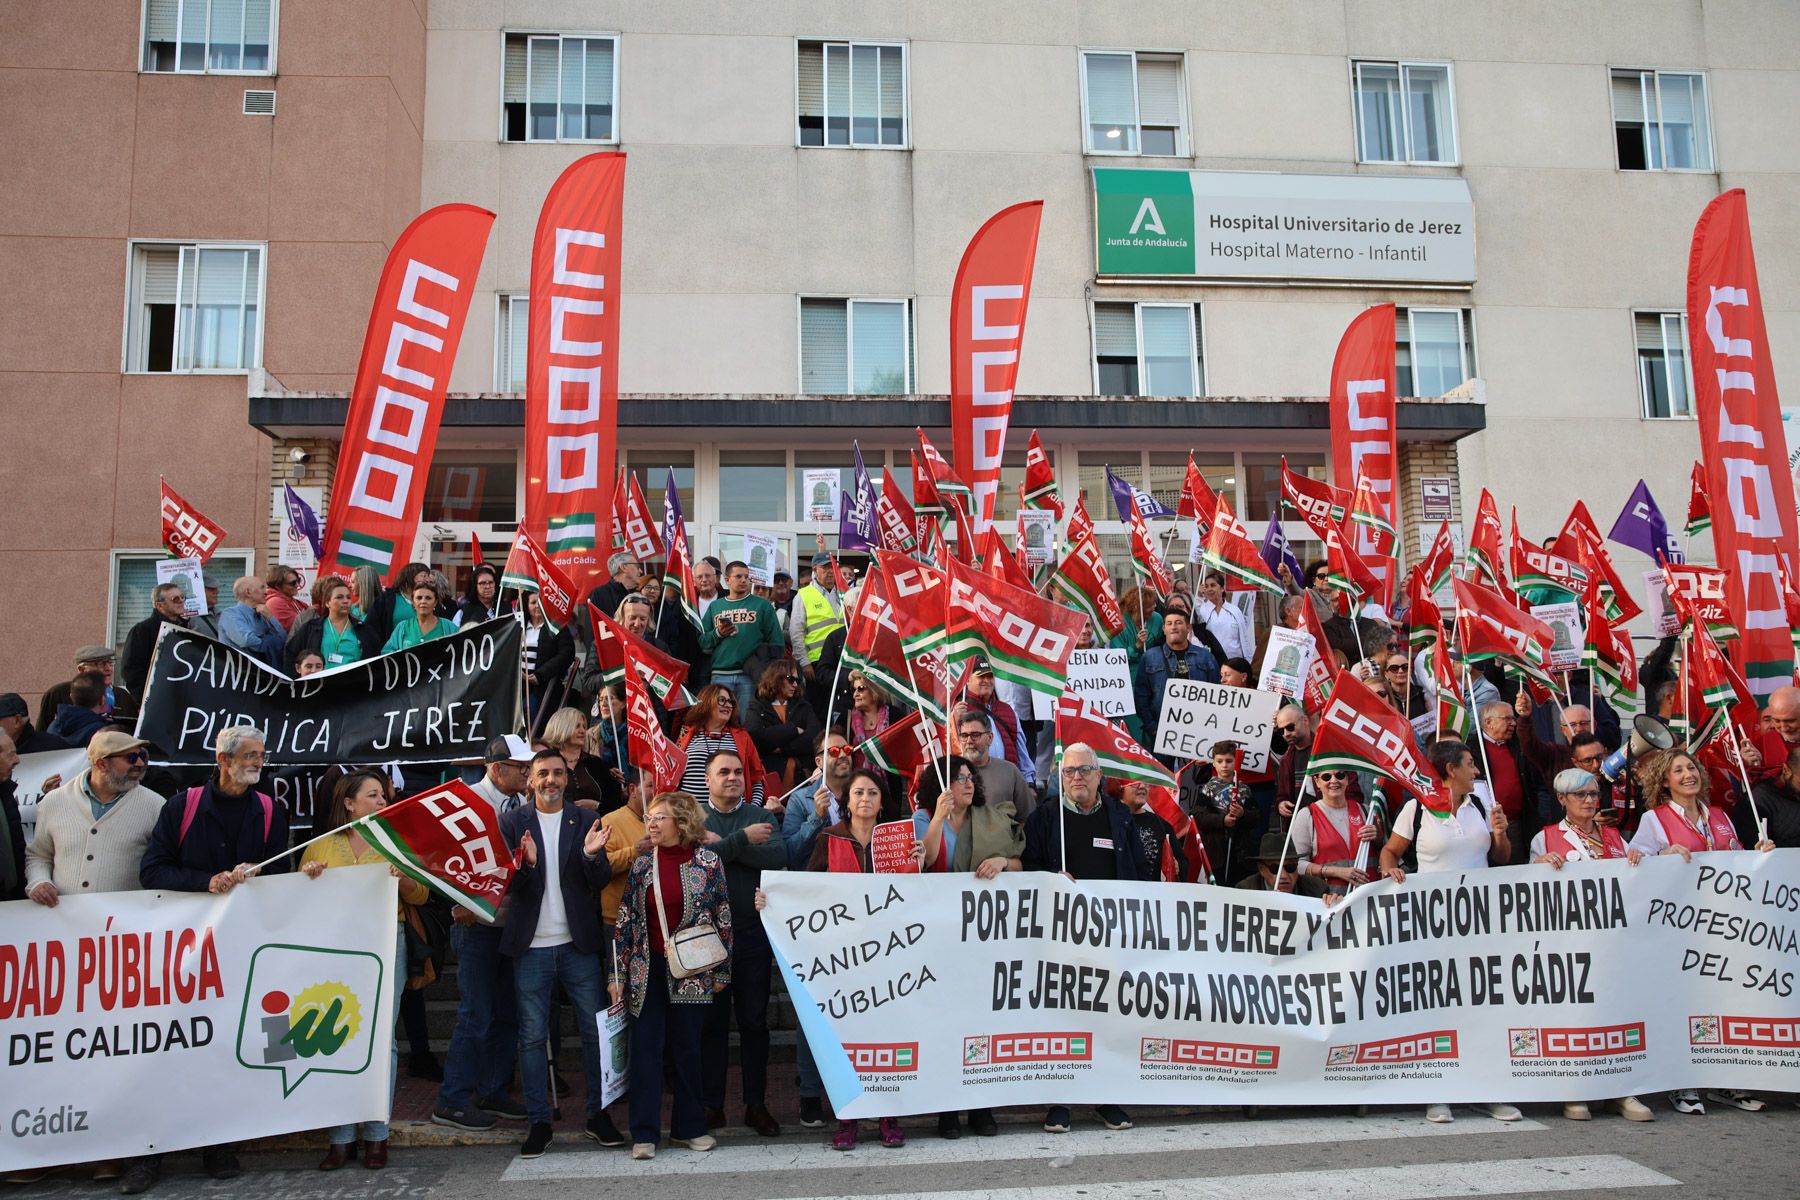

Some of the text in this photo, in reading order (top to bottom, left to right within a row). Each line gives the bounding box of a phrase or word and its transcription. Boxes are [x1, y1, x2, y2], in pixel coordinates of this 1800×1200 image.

[1209, 214, 1462, 235] Hospital Universitario de Jerez
[1106, 237, 1187, 247] Junta de Andalucía
[1210, 241, 1280, 259] Hospital
[1286, 243, 1354, 260] Materno
[1369, 245, 1427, 261] Infantil
[547, 227, 605, 494] CCOO
[348, 258, 459, 519] CCOO
[574, 555, 596, 565] Cádiz
[543, 586, 567, 615] Cádiz
[950, 578, 1069, 662] CCOO
[1097, 594, 1122, 629] Cádiz
[1169, 684, 1251, 708] GIBALBÍN
[372, 701, 486, 750] JEREZ
[1167, 707, 1193, 724] NO
[1204, 713, 1217, 728] A
[1325, 698, 1415, 778] CCOO
[1696, 865, 1800, 912] POR LOS
[786, 884, 904, 940] POR LA
[961, 875, 1628, 957] POR EL HOSPITAL DE JEREZ Y LA ATENCIÓN PRIMARIA
[791, 923, 925, 982] SANIDAD
[78, 916, 224, 1012] PÚBLICA
[1682, 949, 1794, 998] DEL SAS
[992, 941, 1595, 1026] DE JEREZ COSTA NOROESTE Y SIERRA DE CÁDIZ
[9, 1015, 214, 1066] DE CALIDAD
[997, 1038, 1067, 1057] CCOO
[1363, 1037, 1433, 1059] CCOO
[1547, 1030, 1624, 1051] CCOO
[1177, 1044, 1253, 1064] CCOO
[1510, 1059, 1558, 1067] federación
[1560, 1058, 1571, 1066] de
[1573, 1057, 1607, 1067] sanidad
[1614, 1053, 1647, 1064] sectores
[1691, 1046, 1739, 1054] federación
[1756, 1048, 1795, 1057] sanidad
[1691, 1057, 1763, 1066] sociosanitarios
[1765, 1059, 1778, 1067] de
[963, 1064, 1003, 1075] federación
[1005, 1064, 1015, 1072] de
[1016, 1062, 1048, 1072] sanidad
[1056, 1062, 1092, 1070] sectores
[1140, 1062, 1184, 1071] federación
[1199, 1065, 1232, 1075] sanidad
[1241, 1068, 1277, 1076] sectores
[1324, 1070, 1443, 1081] sociosanitarios de Andalucía
[1382, 1061, 1414, 1070] sanidad
[1422, 1060, 1460, 1068] sectores
[1511, 1065, 1632, 1078] sociosanitarios de Andalucía
[864, 1084, 900, 1092] ndalucía
[882, 1074, 918, 1082] sectores
[962, 1072, 1075, 1086] sociosanitarios de Andalucía
[1140, 1073, 1203, 1081] sociosanitarios
[1217, 1075, 1258, 1084] Andalucía
[11, 1105, 89, 1138] Cádiz
